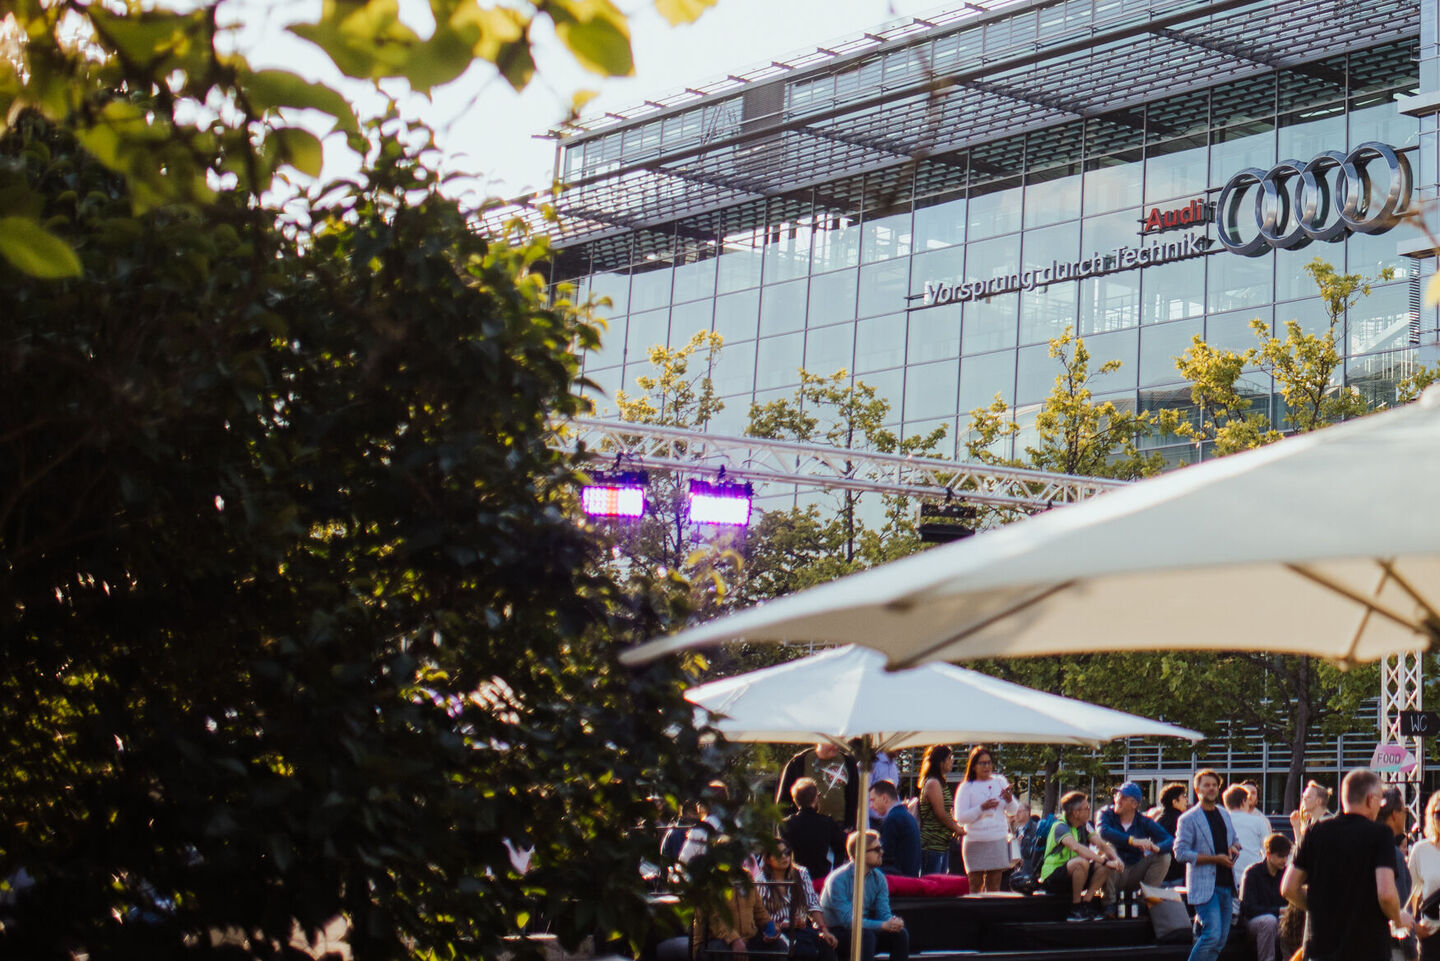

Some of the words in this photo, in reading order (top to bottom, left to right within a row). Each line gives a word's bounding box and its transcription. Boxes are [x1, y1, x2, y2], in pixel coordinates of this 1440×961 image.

[1145, 198, 1204, 232] Audi
[925, 270, 1038, 304] Vorsprung
[1043, 251, 1105, 282] durch
[1112, 232, 1202, 270] Technik
[1410, 714, 1428, 732] WC
[1377, 752, 1402, 765] FOOD
